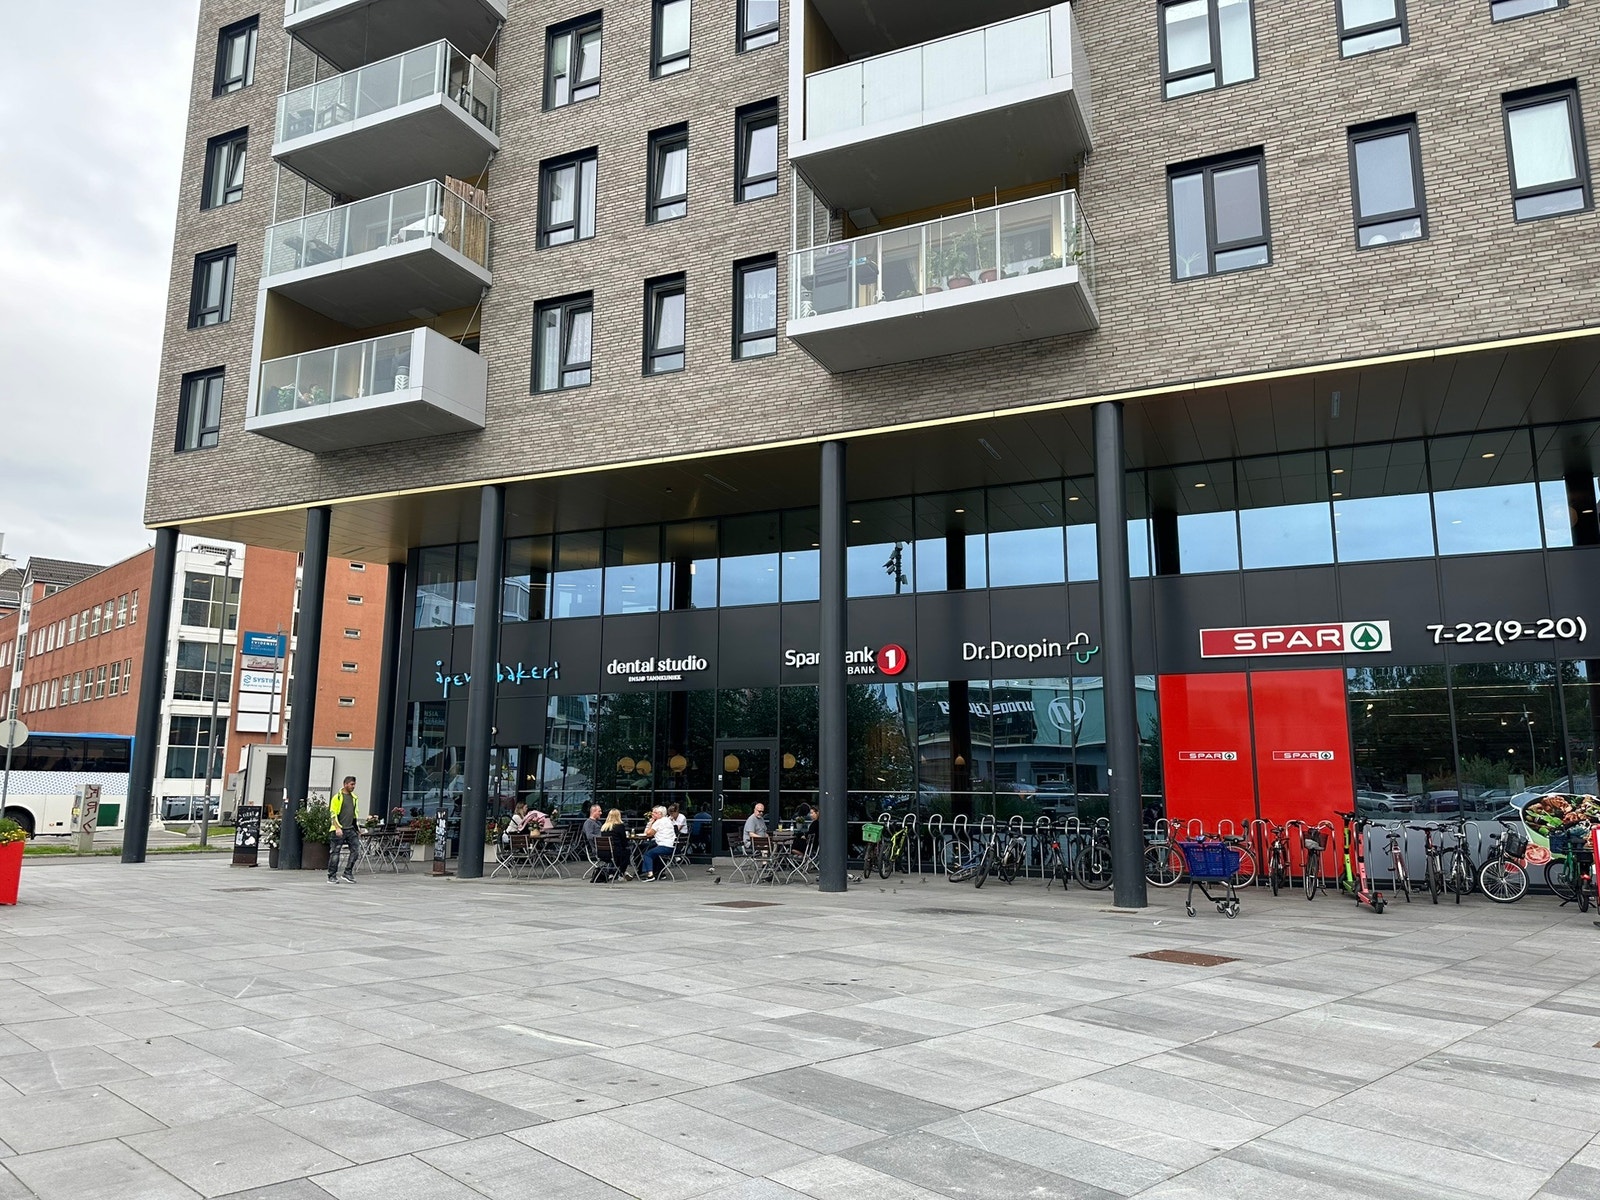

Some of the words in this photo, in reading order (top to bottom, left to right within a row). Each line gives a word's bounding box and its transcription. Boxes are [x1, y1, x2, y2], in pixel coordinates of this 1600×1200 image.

[1233, 629, 1341, 650] SPAR
[607, 657, 654, 674] dental
[658, 655, 707, 671] studio
[885, 649, 896, 669] 1
[496, 661, 559, 684] bakeri
[846, 666, 875, 675] BANK
